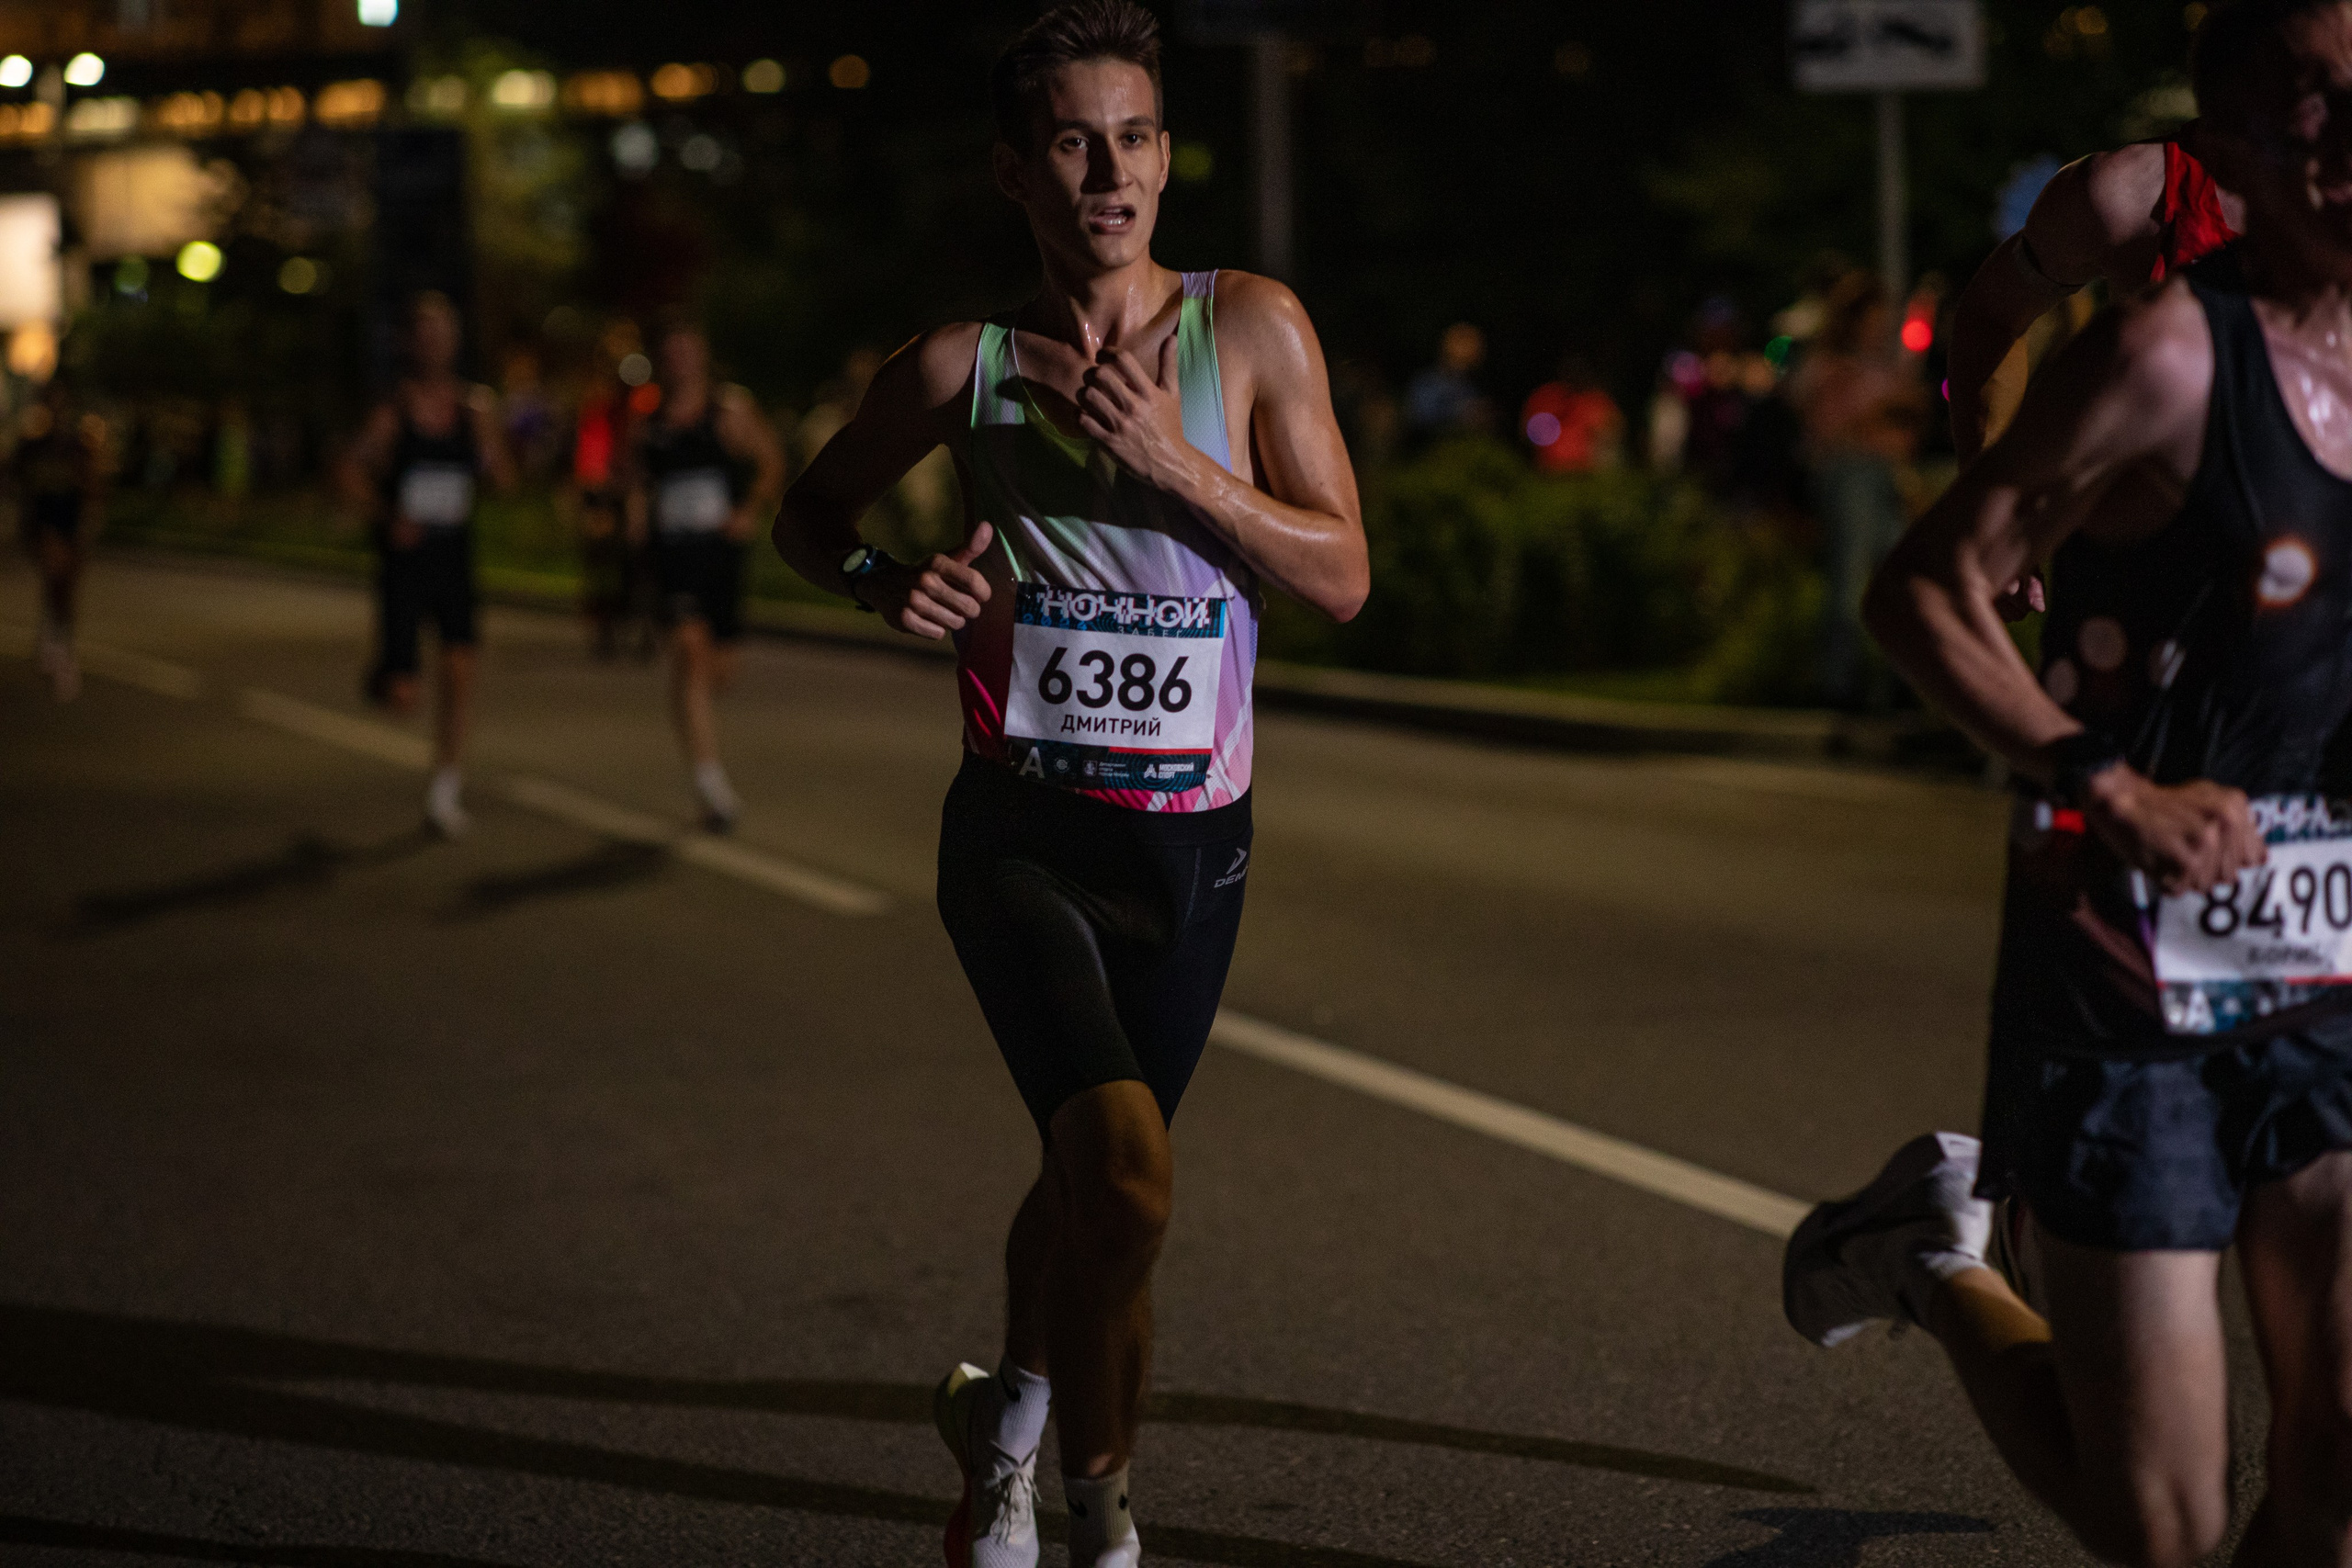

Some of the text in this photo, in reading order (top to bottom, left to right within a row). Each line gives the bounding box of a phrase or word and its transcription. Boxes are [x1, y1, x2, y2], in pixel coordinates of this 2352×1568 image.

[1036, 586, 1210, 628] НОЧНОЙ
[1037, 646, 1193, 713] 6386
[1060, 713, 1161, 737] ДМИТРИЙ
[2200, 862, 2352, 939] 8490
